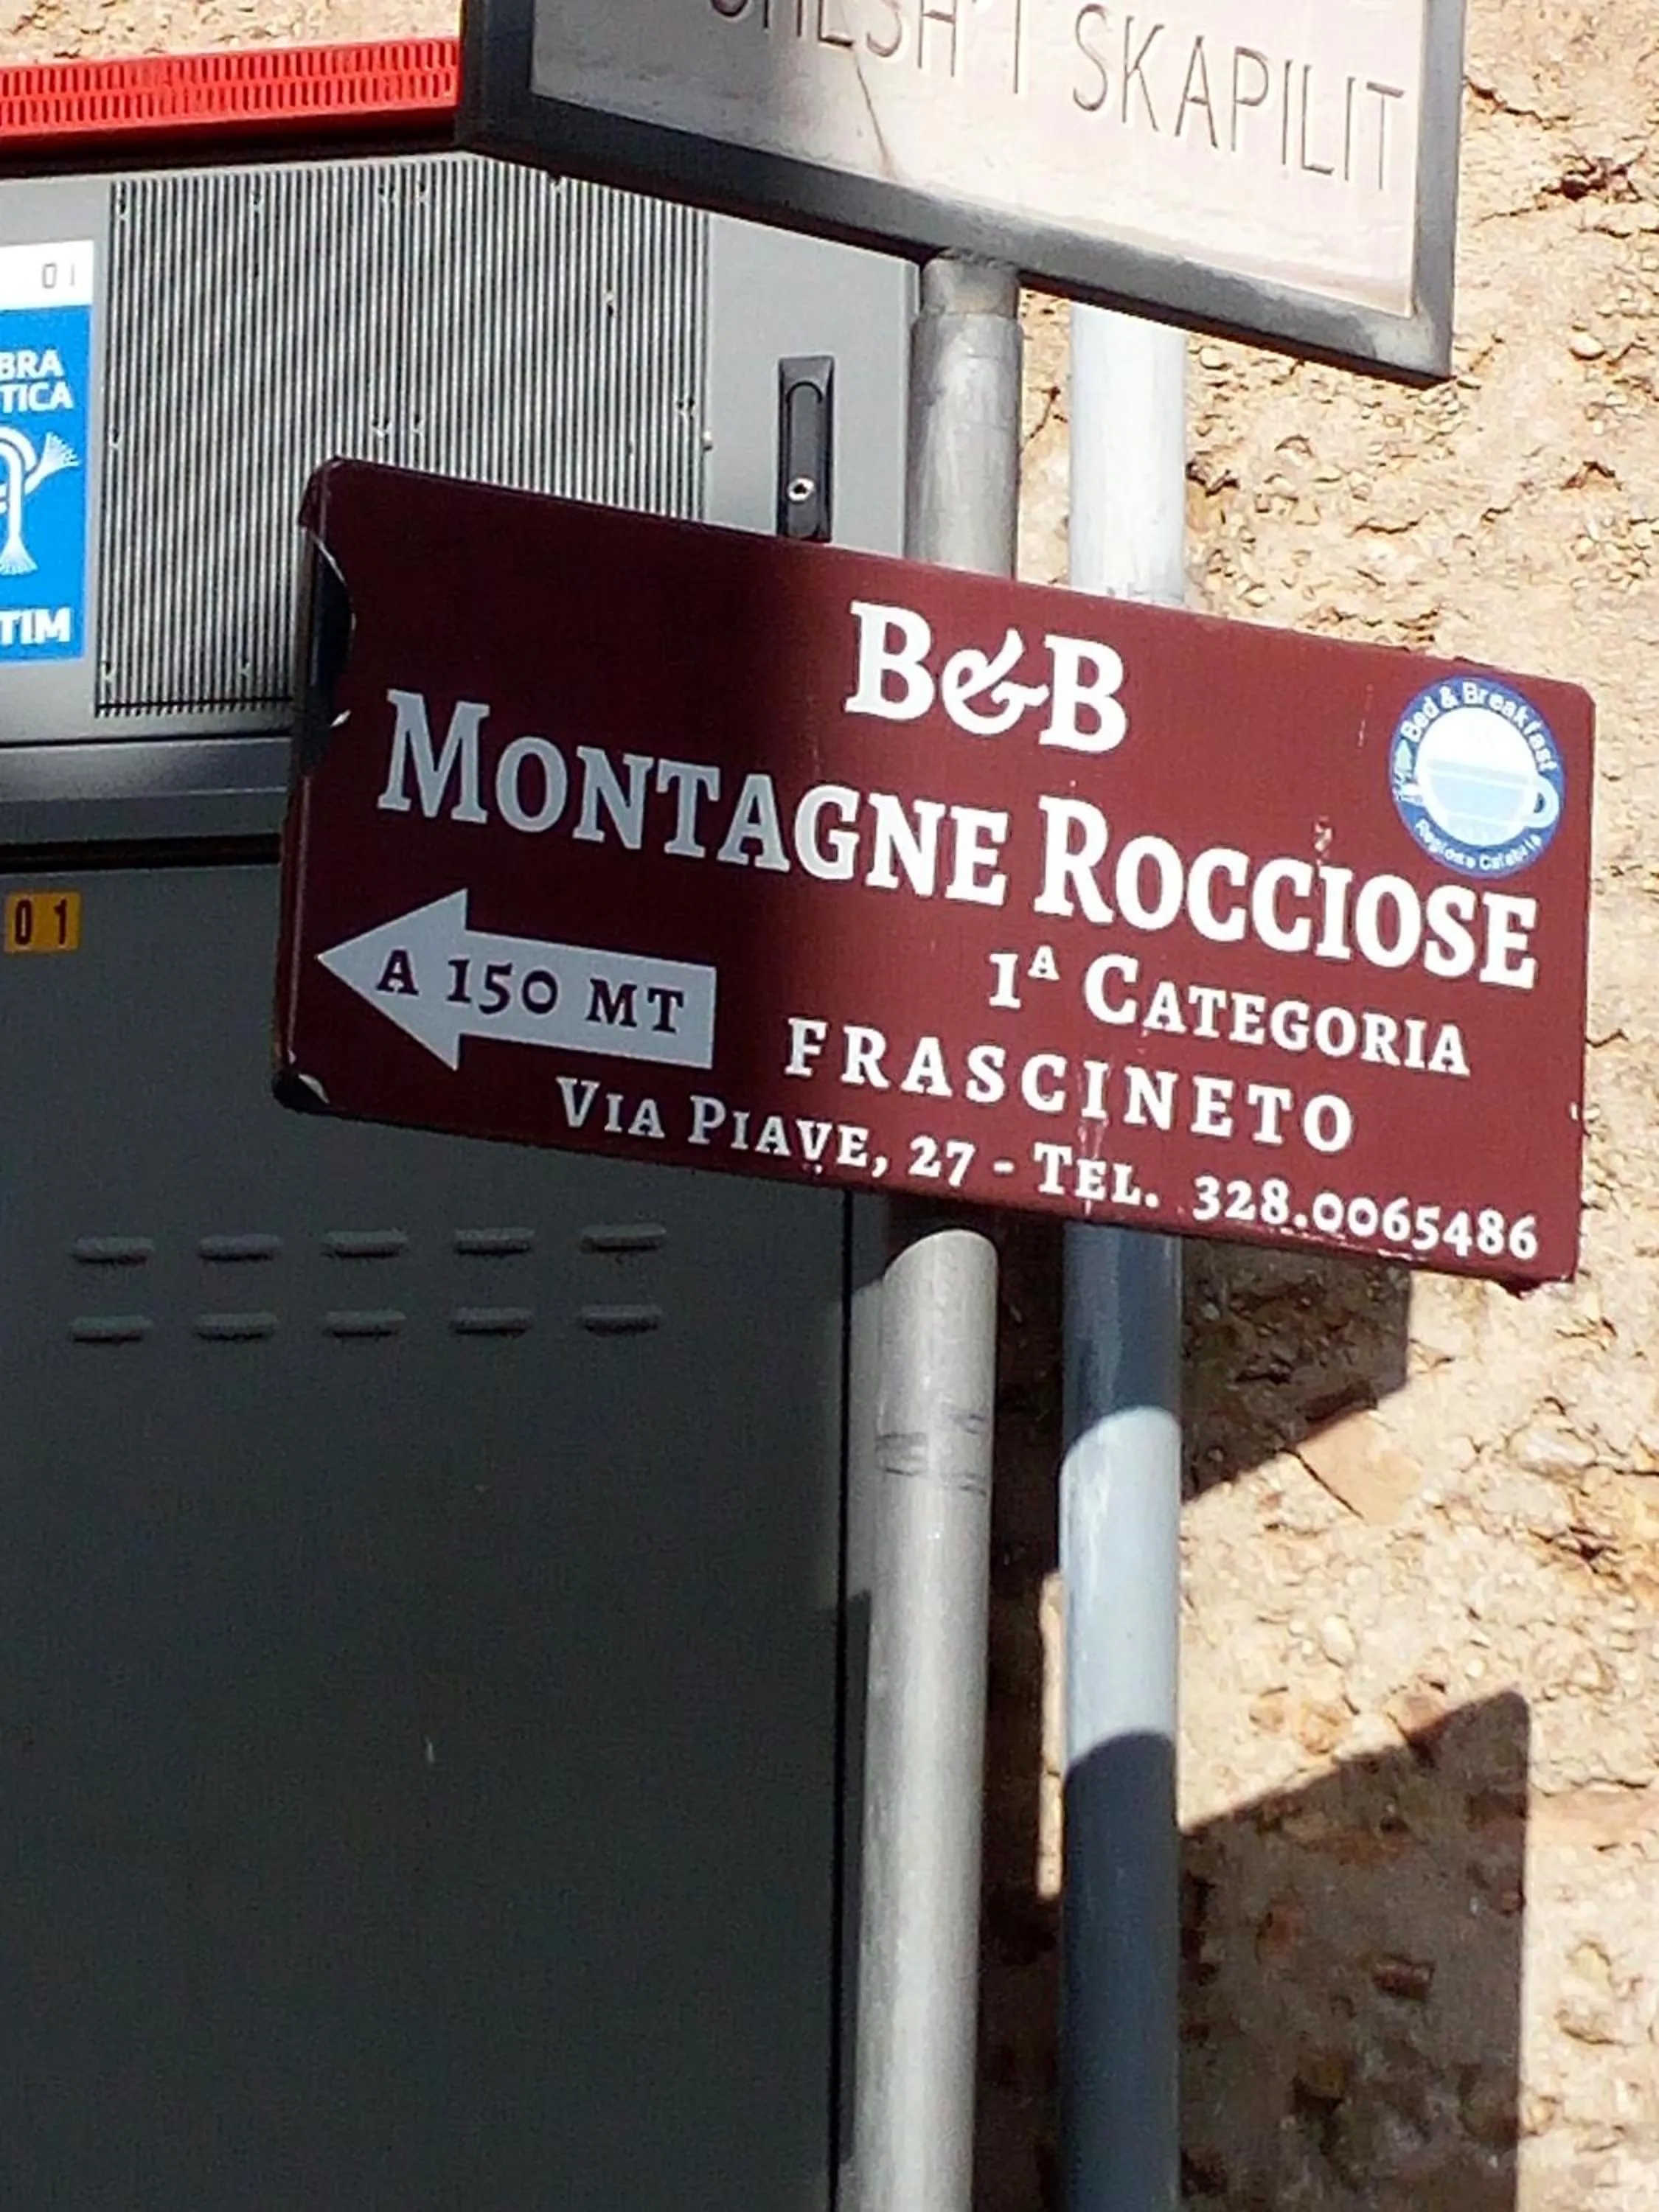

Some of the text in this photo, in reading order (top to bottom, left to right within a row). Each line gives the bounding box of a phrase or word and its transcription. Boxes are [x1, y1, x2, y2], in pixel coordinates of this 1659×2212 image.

[1072, 3, 1405, 190] SKAPILIT
[0, 607, 71, 644] TIM
[846, 601, 1127, 753] B&B
[1401, 696, 1440, 742] Bed
[1439, 685, 1459, 709] &
[379, 690, 1537, 989] MONTAGNE ROCCIOSE
[376, 950, 684, 1034] A 150 MT
[1085, 954, 1470, 1076] CATEGORIA
[785, 1018, 1353, 1152] FRASCINETO
[556, 1077, 665, 1138] VIA
[689, 1096, 888, 1178] PIAVE,
[909, 1136, 975, 1186] 27
[1034, 1142, 1159, 1207] TEL.
[1192, 1175, 1538, 1260] 328.0065486
